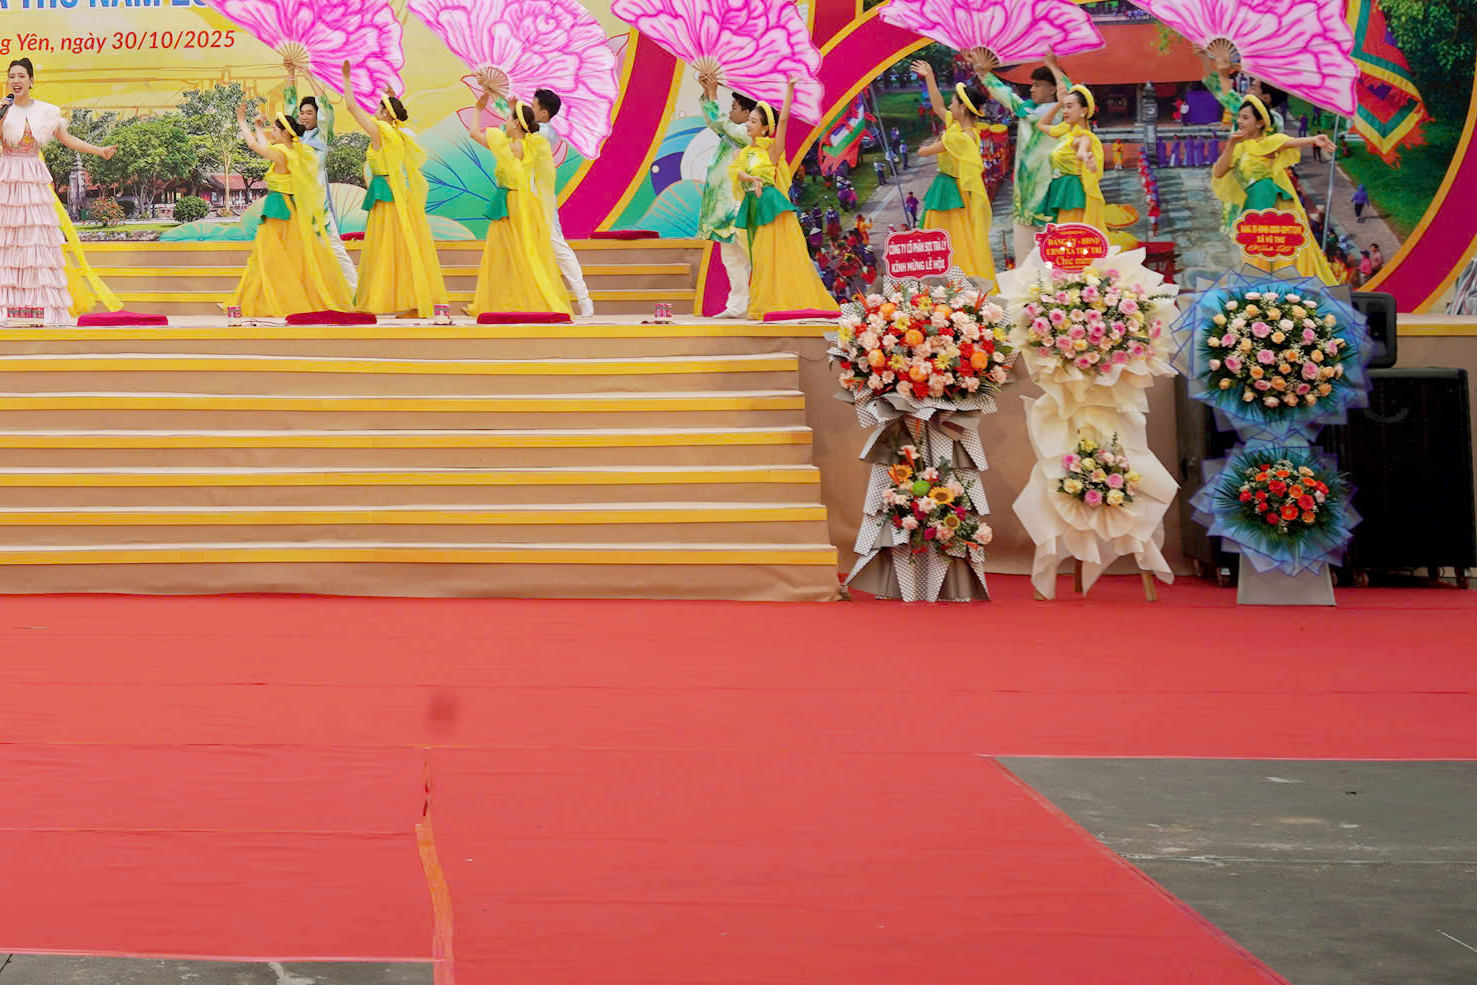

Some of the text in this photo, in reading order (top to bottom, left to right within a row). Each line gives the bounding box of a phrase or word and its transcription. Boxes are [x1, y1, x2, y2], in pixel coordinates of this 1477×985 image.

[16, 33, 55, 53] Yên,
[60, 31, 107, 55] ngày
[111, 28, 236, 51] 30/10/2025
